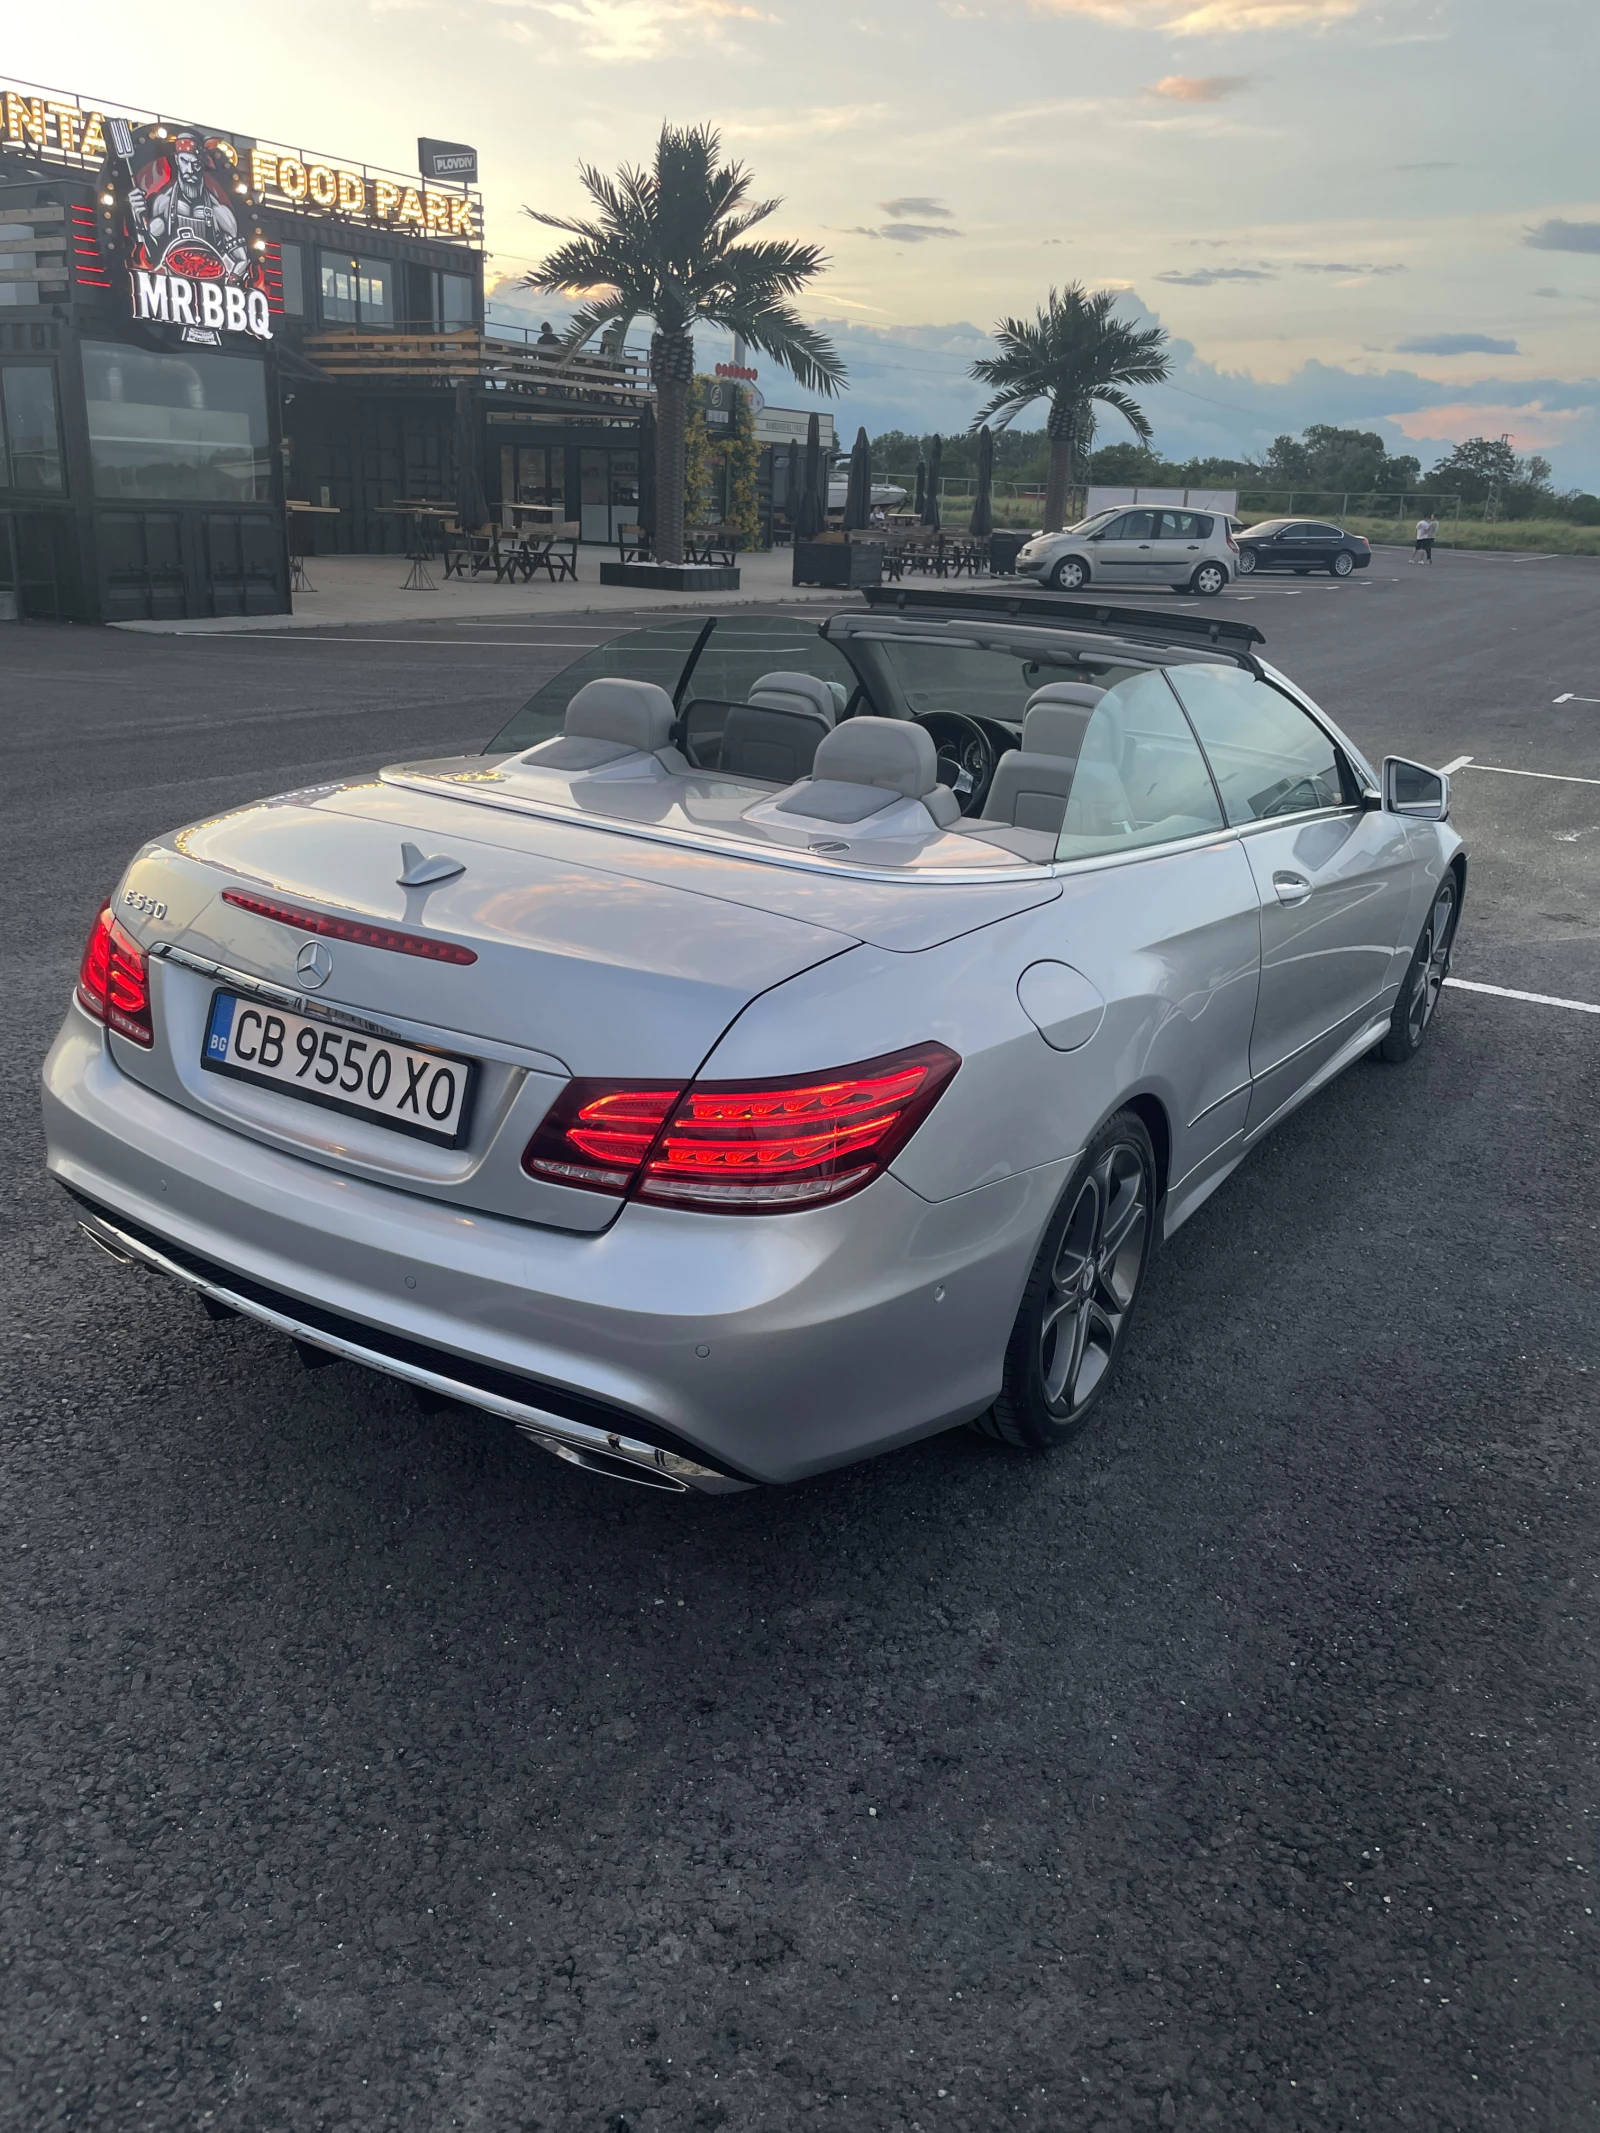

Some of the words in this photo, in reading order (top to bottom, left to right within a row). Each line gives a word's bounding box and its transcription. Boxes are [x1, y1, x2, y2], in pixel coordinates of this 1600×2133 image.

[436, 157, 473, 170] PLOVDIV
[250, 148, 365, 212] FOOD
[374, 179, 477, 237] PARK
[210, 1034, 227, 1052] BG
[235, 1009, 286, 1067] CB
[296, 1026, 392, 1100] 9550
[396, 1056, 455, 1121] XO
